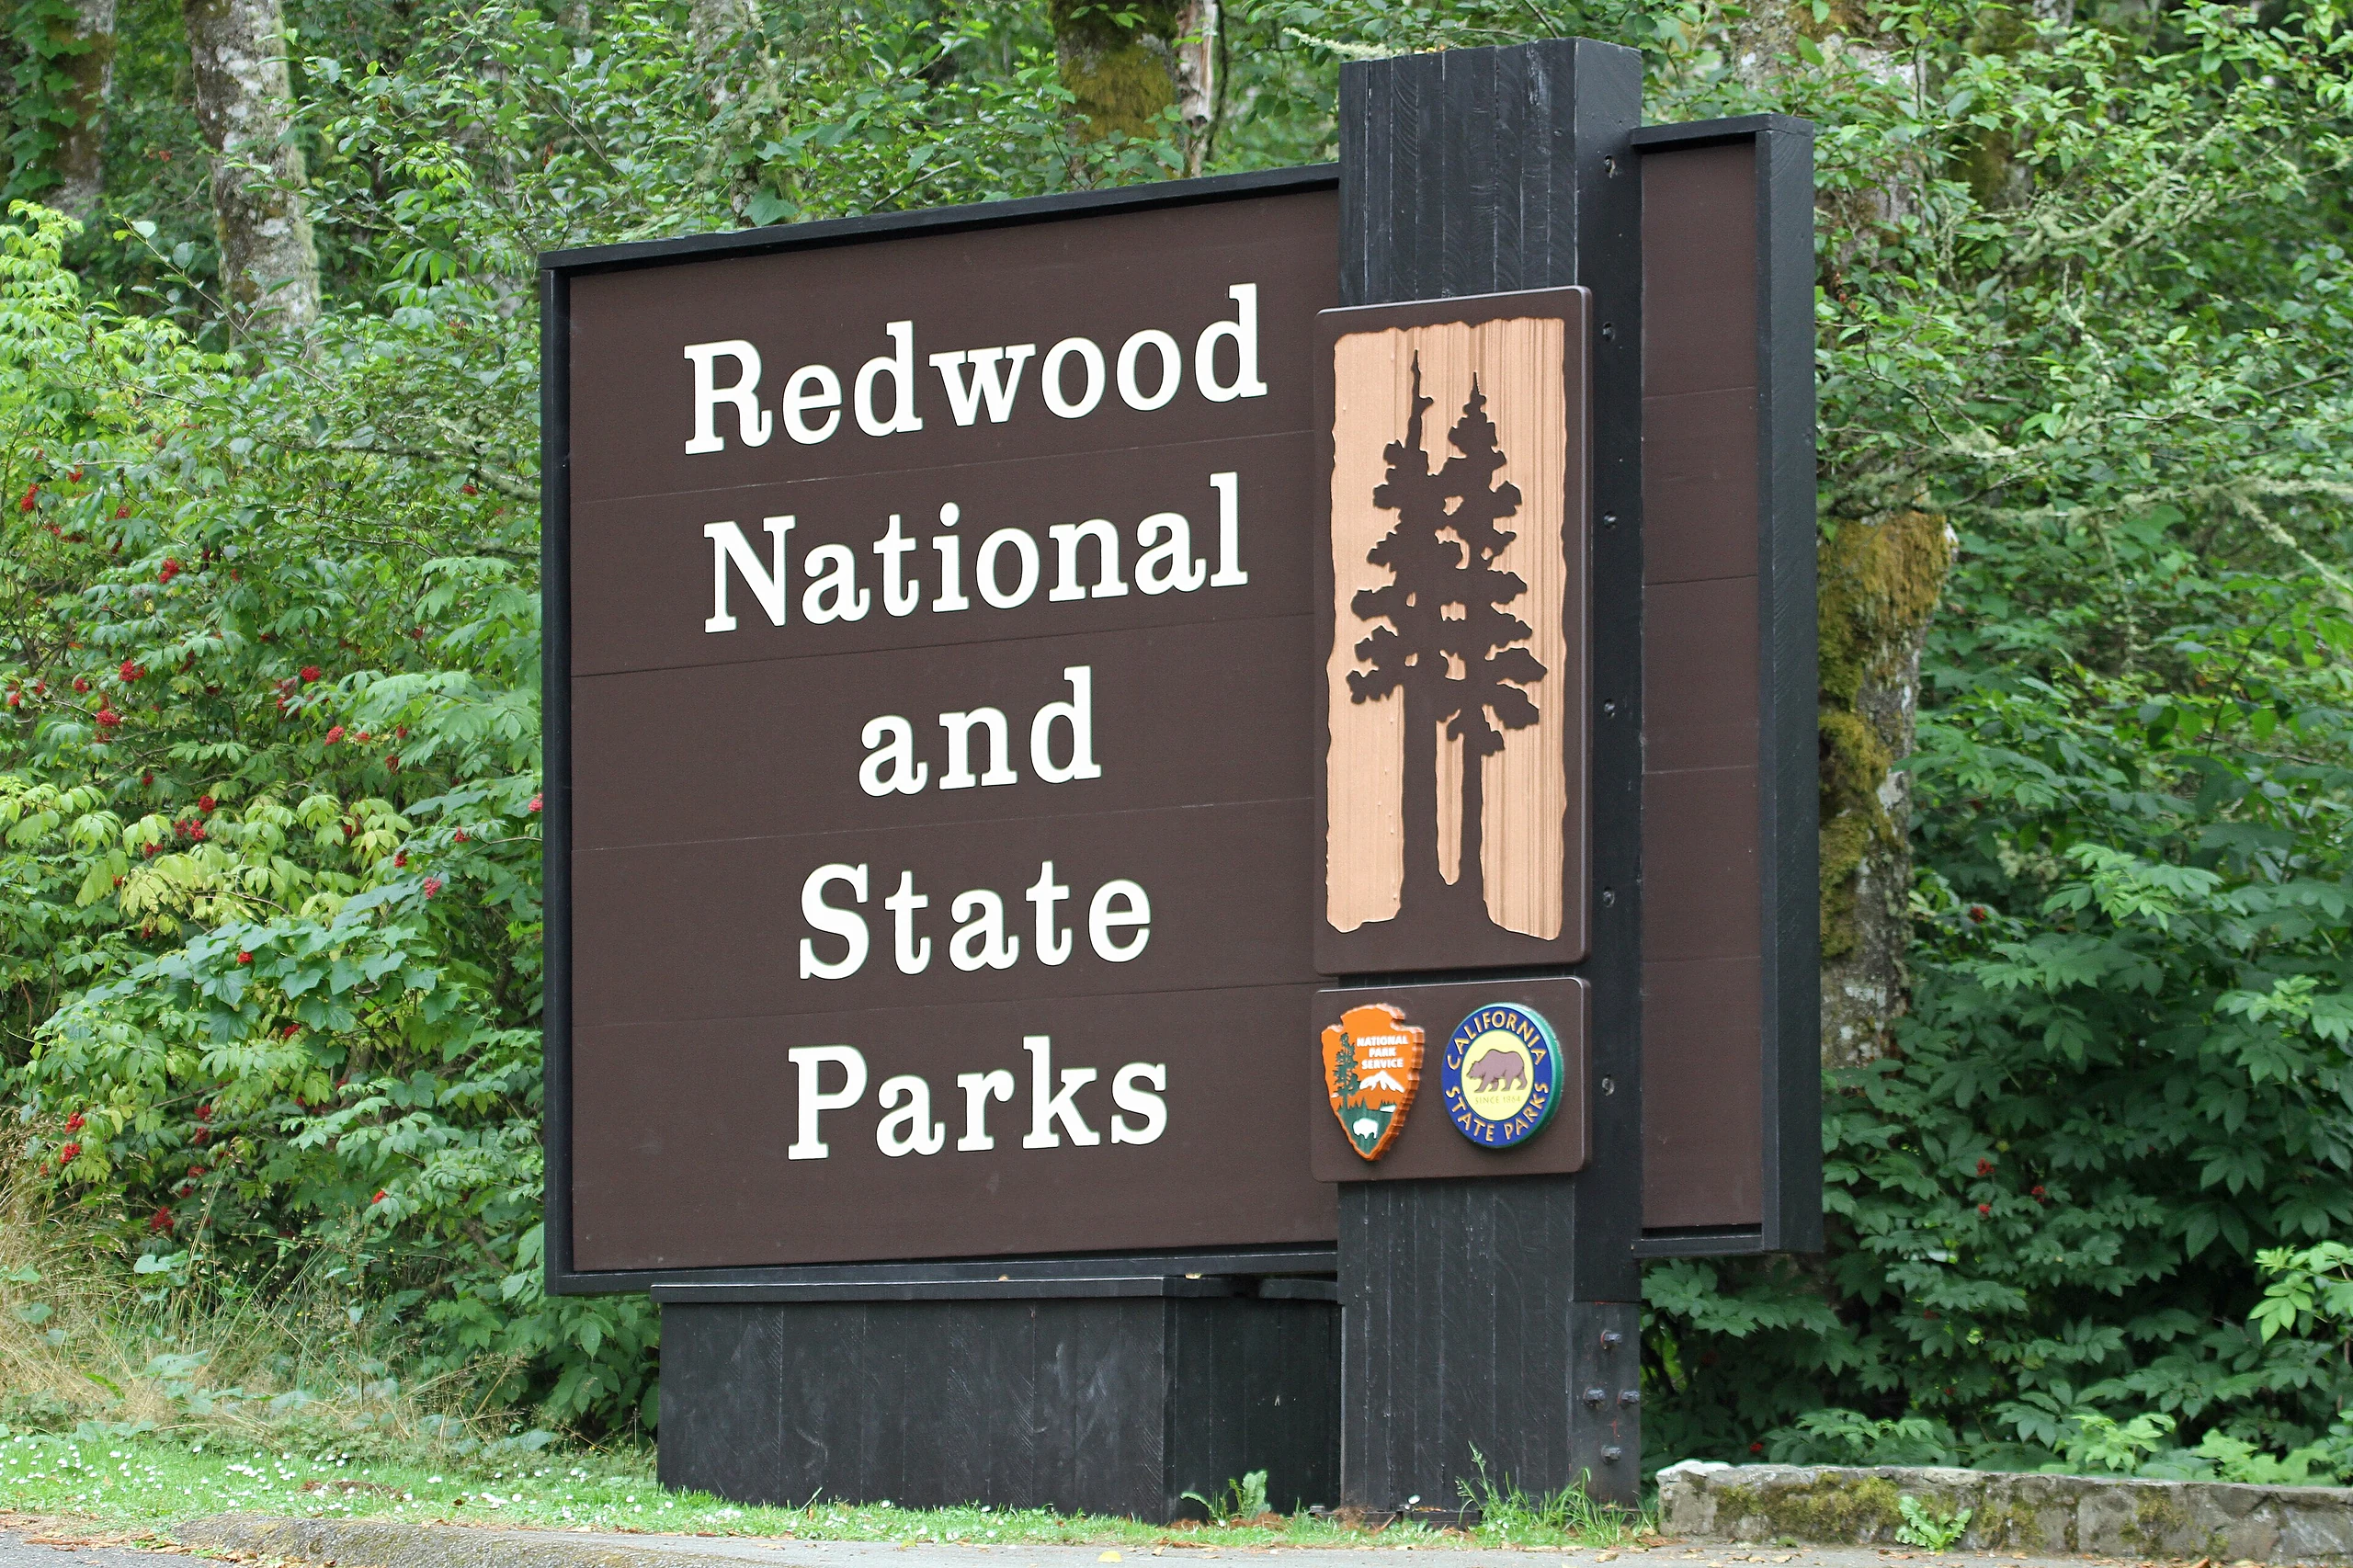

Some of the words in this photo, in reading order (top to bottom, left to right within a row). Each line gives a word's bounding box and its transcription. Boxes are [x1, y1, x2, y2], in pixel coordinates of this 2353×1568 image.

[684, 282, 1268, 456] Redwood
[703, 472, 1248, 634] National
[858, 665, 1102, 798] and
[798, 861, 1152, 981] State
[1357, 1035, 1408, 1047] NATIONAL
[1361, 1058, 1404, 1070] SERVICE
[1369, 1047, 1397, 1058] PARK
[1447, 1010, 1547, 1070] CALIFORNIA
[788, 1035, 1168, 1161] Parks
[1446, 1085, 1495, 1142] STATE
[1504, 1083, 1549, 1140] PARKS
[1474, 1096, 1500, 1105] SINCE
